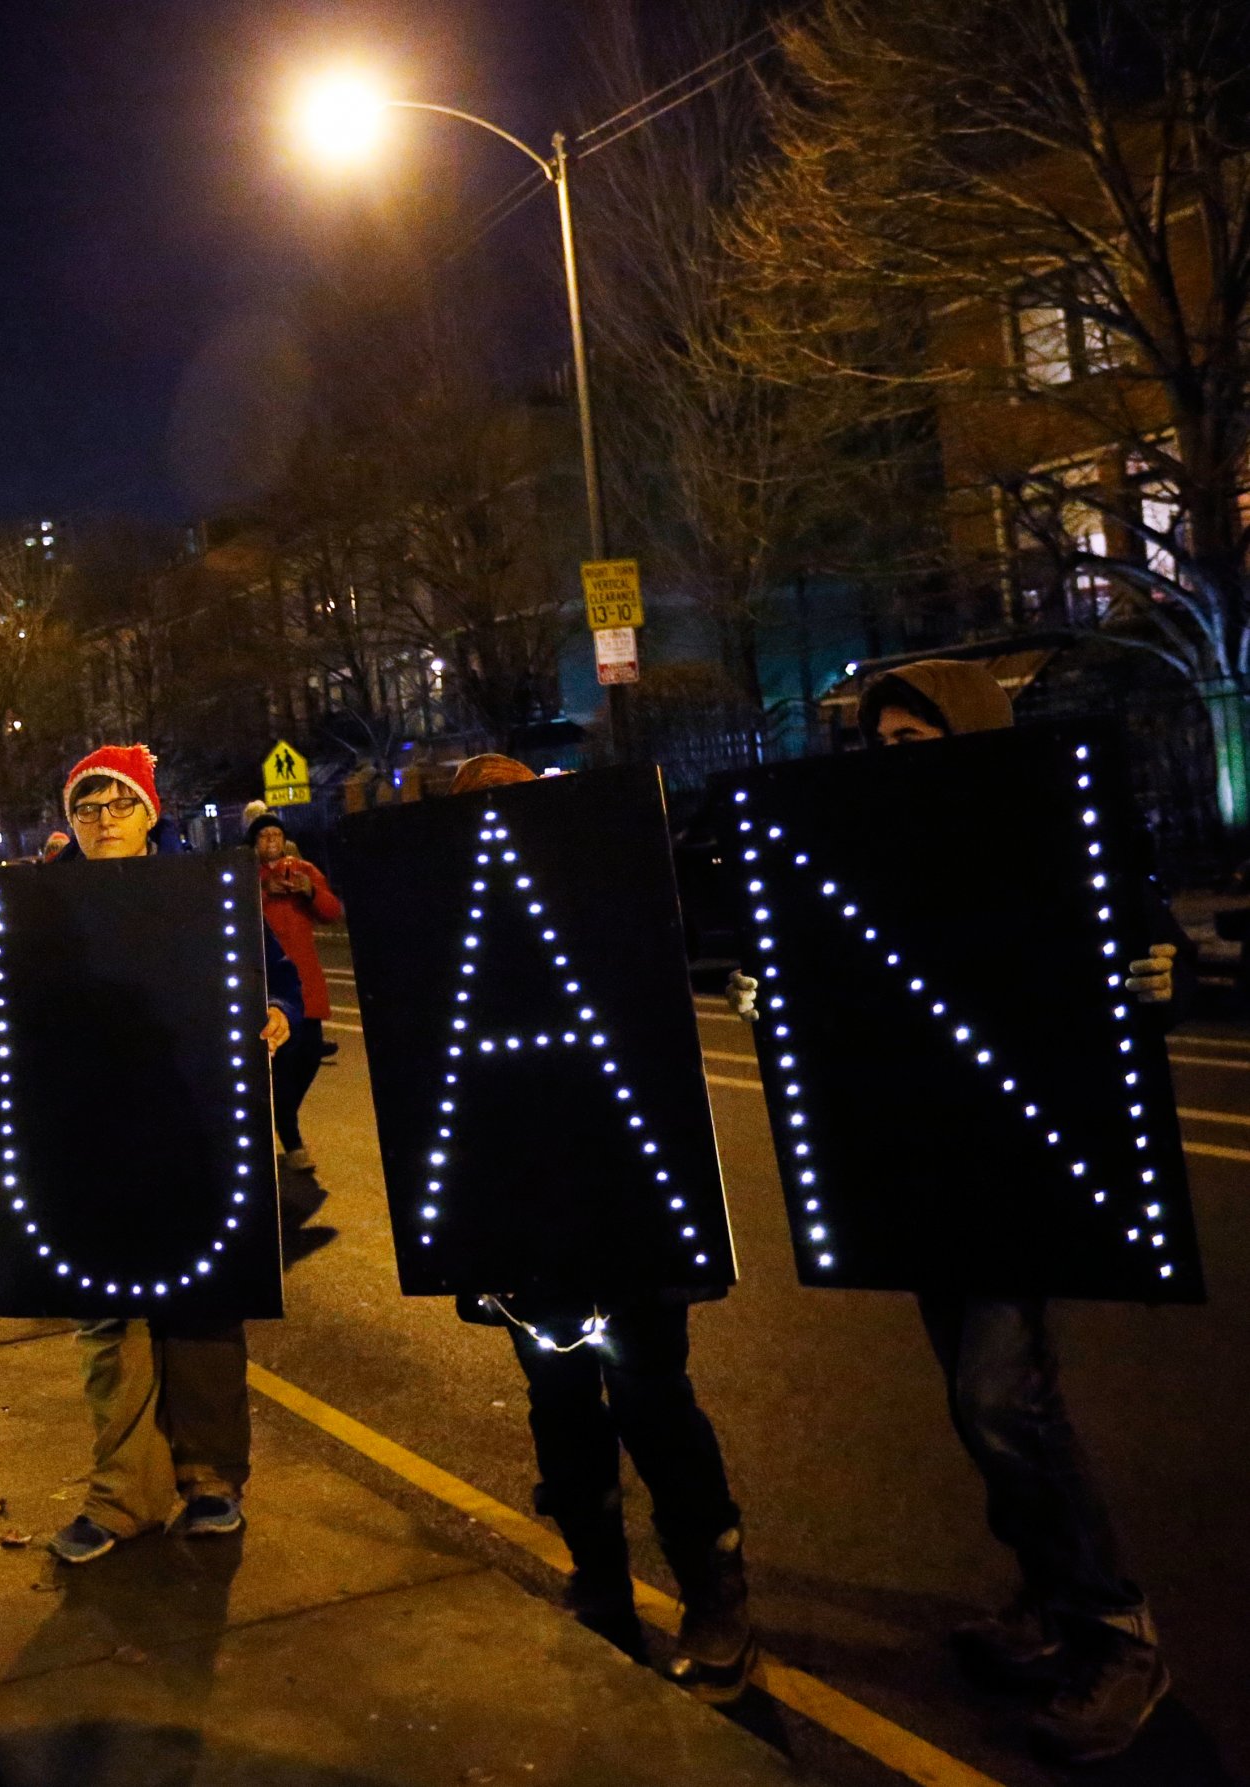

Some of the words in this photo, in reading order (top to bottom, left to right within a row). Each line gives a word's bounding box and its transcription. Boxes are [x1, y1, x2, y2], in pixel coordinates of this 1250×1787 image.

[592, 578, 630, 591] VERTICAL
[589, 590, 636, 604] CLEARANCE
[272, 789, 306, 801] AHAD
